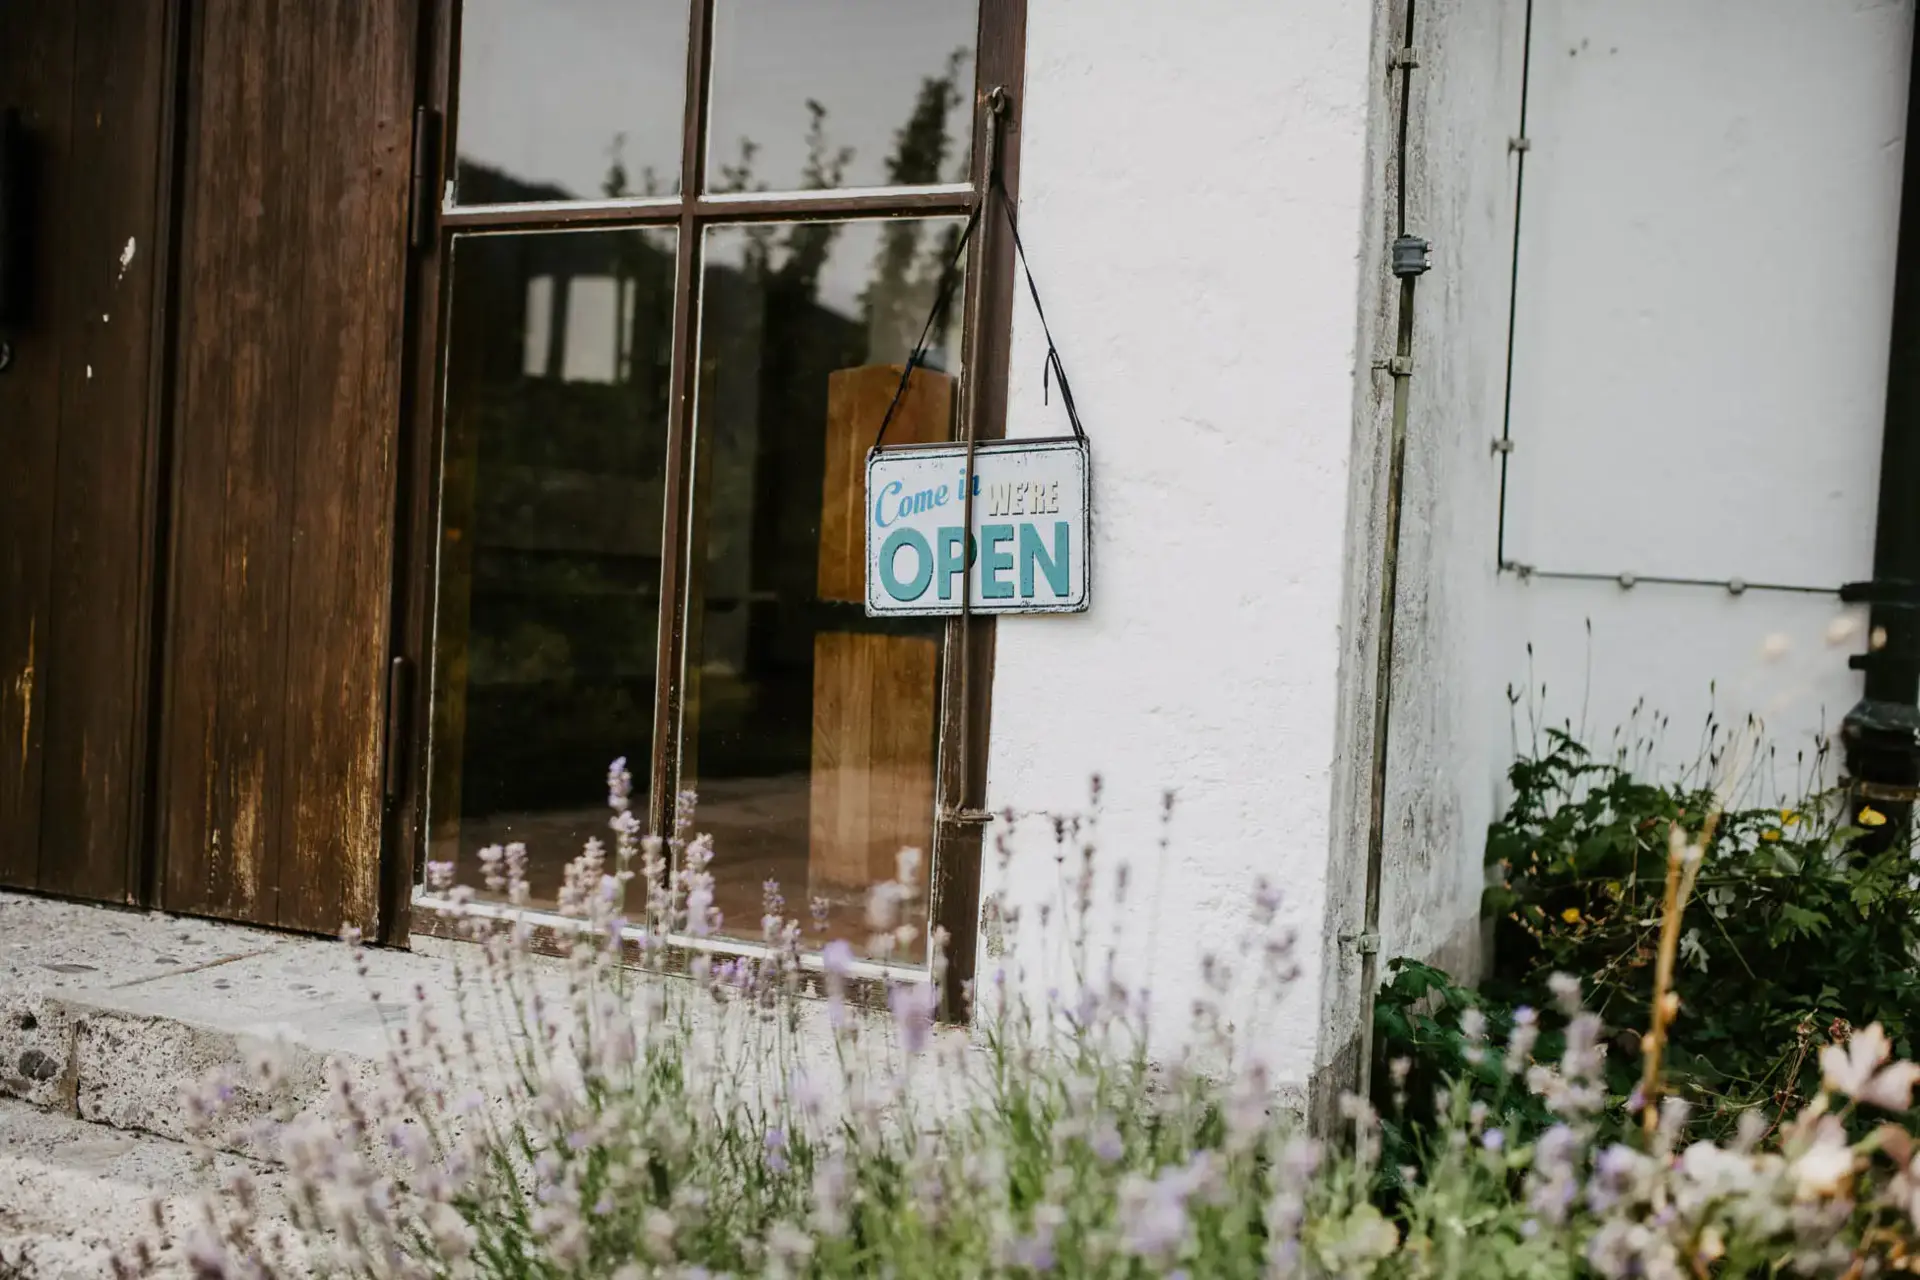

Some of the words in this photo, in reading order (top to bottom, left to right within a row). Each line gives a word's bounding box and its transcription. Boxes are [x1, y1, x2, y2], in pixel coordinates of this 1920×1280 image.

[875, 480, 950, 528] Come
[988, 480, 1060, 516] WE'RE
[879, 521, 1070, 602] OPEN
